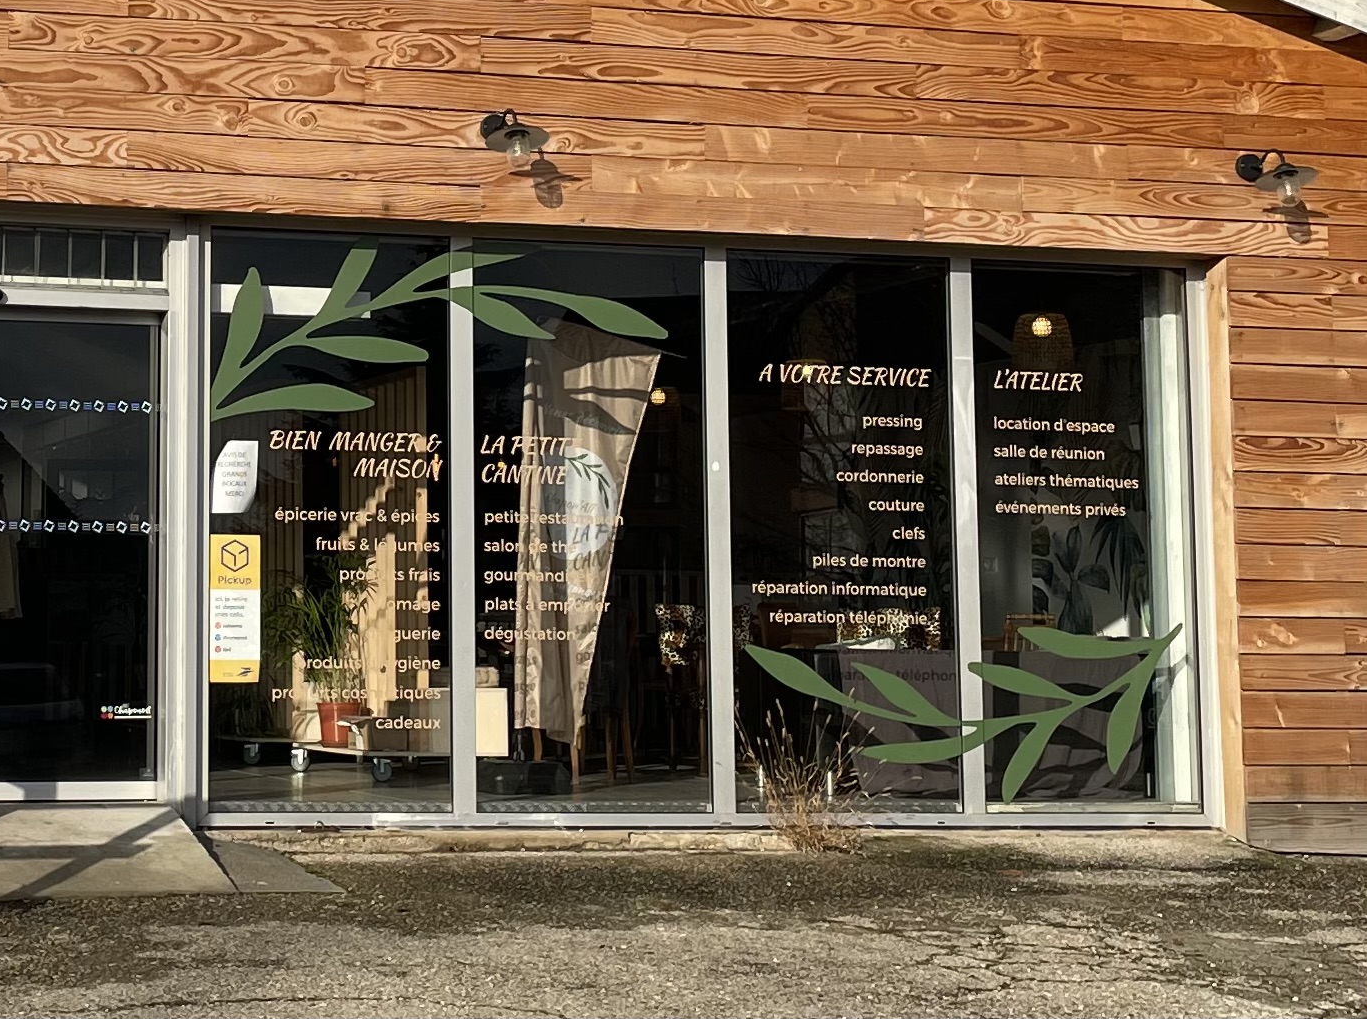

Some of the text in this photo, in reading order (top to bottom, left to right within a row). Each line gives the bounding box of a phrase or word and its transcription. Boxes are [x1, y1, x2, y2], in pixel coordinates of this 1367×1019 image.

[759, 364, 932, 387] A VOTRE SERVICE
[993, 369, 1083, 392] L'ATELIER
[862, 414, 923, 430] pressing
[993, 416, 1115, 435] location d'espace
[269, 430, 442, 453] BIEN MANGER &
[480, 434, 505, 454] LA
[851, 443, 924, 458] repassage
[993, 444, 1105, 460] salle de réunion
[353, 458, 443, 480] MAISON
[481, 463, 568, 485] CANTINE
[836, 469, 924, 484] cordonnerie
[994, 472, 1139, 491] ateliers thématiques
[868, 499, 925, 512] couture
[995, 500, 1126, 518] événements privés
[274, 507, 336, 523] épicerie
[340, 511, 372, 522] vrac
[377, 509, 387, 522] &
[484, 510, 529, 525] petite
[892, 526, 926, 540] clefs
[315, 537, 440, 554] fruits & léumes
[483, 539, 523, 553] salon
[529, 540, 548, 553] de
[812, 552, 926, 568] piles de montre
[218, 575, 252, 585] Pickup
[339, 566, 441, 582] prots frais
[751, 580, 927, 599] réparation informatique
[378, 599, 441, 613] omage
[484, 597, 522, 613] plats
[769, 609, 845, 625] réparation
[376, 626, 441, 642] guerie
[484, 625, 576, 642] dégustation
[299, 655, 441, 672] roduits giène
[271, 685, 441, 702] proits costiques
[375, 715, 441, 729] cadeaux
